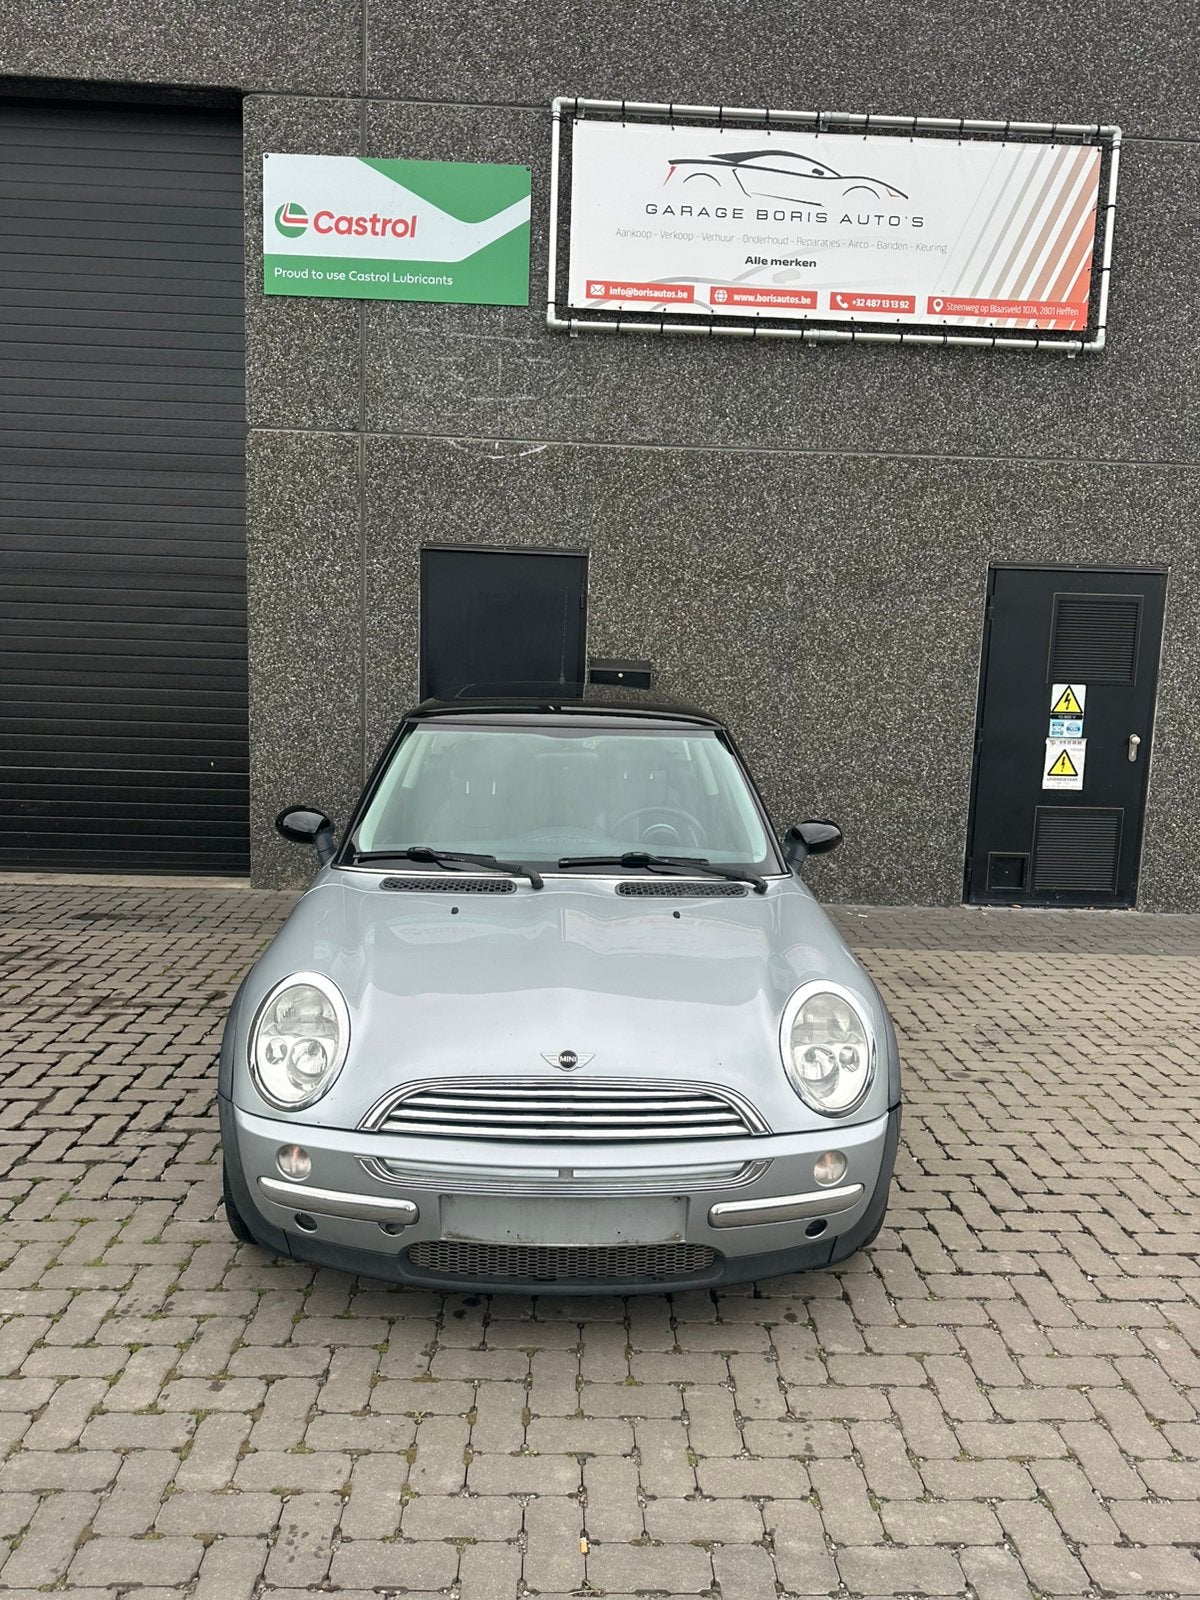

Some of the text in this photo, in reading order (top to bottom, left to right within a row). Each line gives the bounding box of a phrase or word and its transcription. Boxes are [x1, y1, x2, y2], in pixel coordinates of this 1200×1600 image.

[645, 203, 924, 228] GARAGE BORIS AUTO'S
[313, 210, 418, 238] Castrol
[616, 228, 652, 239] Aankoop
[660, 230, 693, 241] Verkoop
[702, 232, 734, 242] Verhuur
[742, 234, 788, 246] Onderhoud
[797, 237, 840, 248] Reparaties
[848, 239, 869, 249] Airco
[877, 240, 908, 251] Banden
[916, 242, 947, 254] Keuring
[745, 255, 817, 268] Alle merken
[274, 267, 453, 286] Proud to use Castrol Lubricants
[609, 286, 688, 299] info@borisautos.be
[733, 292, 811, 305] www.borisautos.be
[852, 298, 910, 309] +32 487 13 13 92
[946, 302, 979, 313] Steenweg
[980, 305, 989, 314] op
[990, 304, 1021, 314] Blaasveld
[1040, 306, 1055, 315] 2801
[1056, 307, 1079, 316] Heffen
[559, 1055, 577, 1063] MINI
